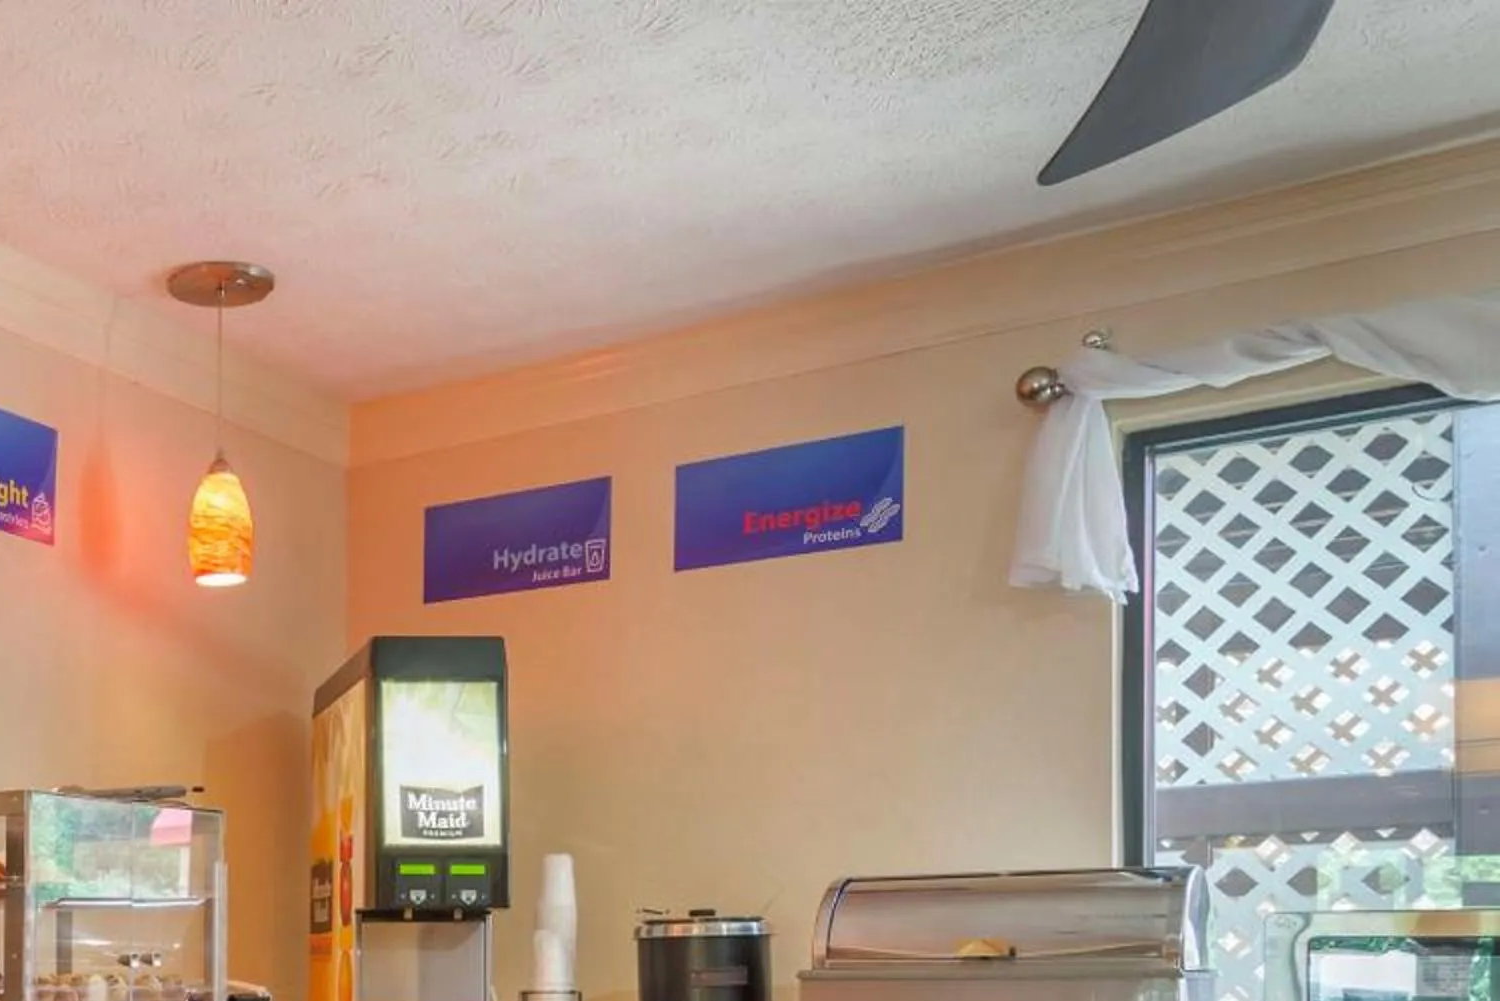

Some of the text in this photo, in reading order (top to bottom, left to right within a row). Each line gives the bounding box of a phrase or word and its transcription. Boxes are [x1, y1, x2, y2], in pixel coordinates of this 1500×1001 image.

[743, 501, 862, 536] Energize
[803, 527, 861, 545] Proteins
[493, 542, 584, 573] Hydrate
[532, 566, 583, 583] Juice Bar
[407, 791, 478, 812] Minute
[417, 810, 471, 830] Maid
